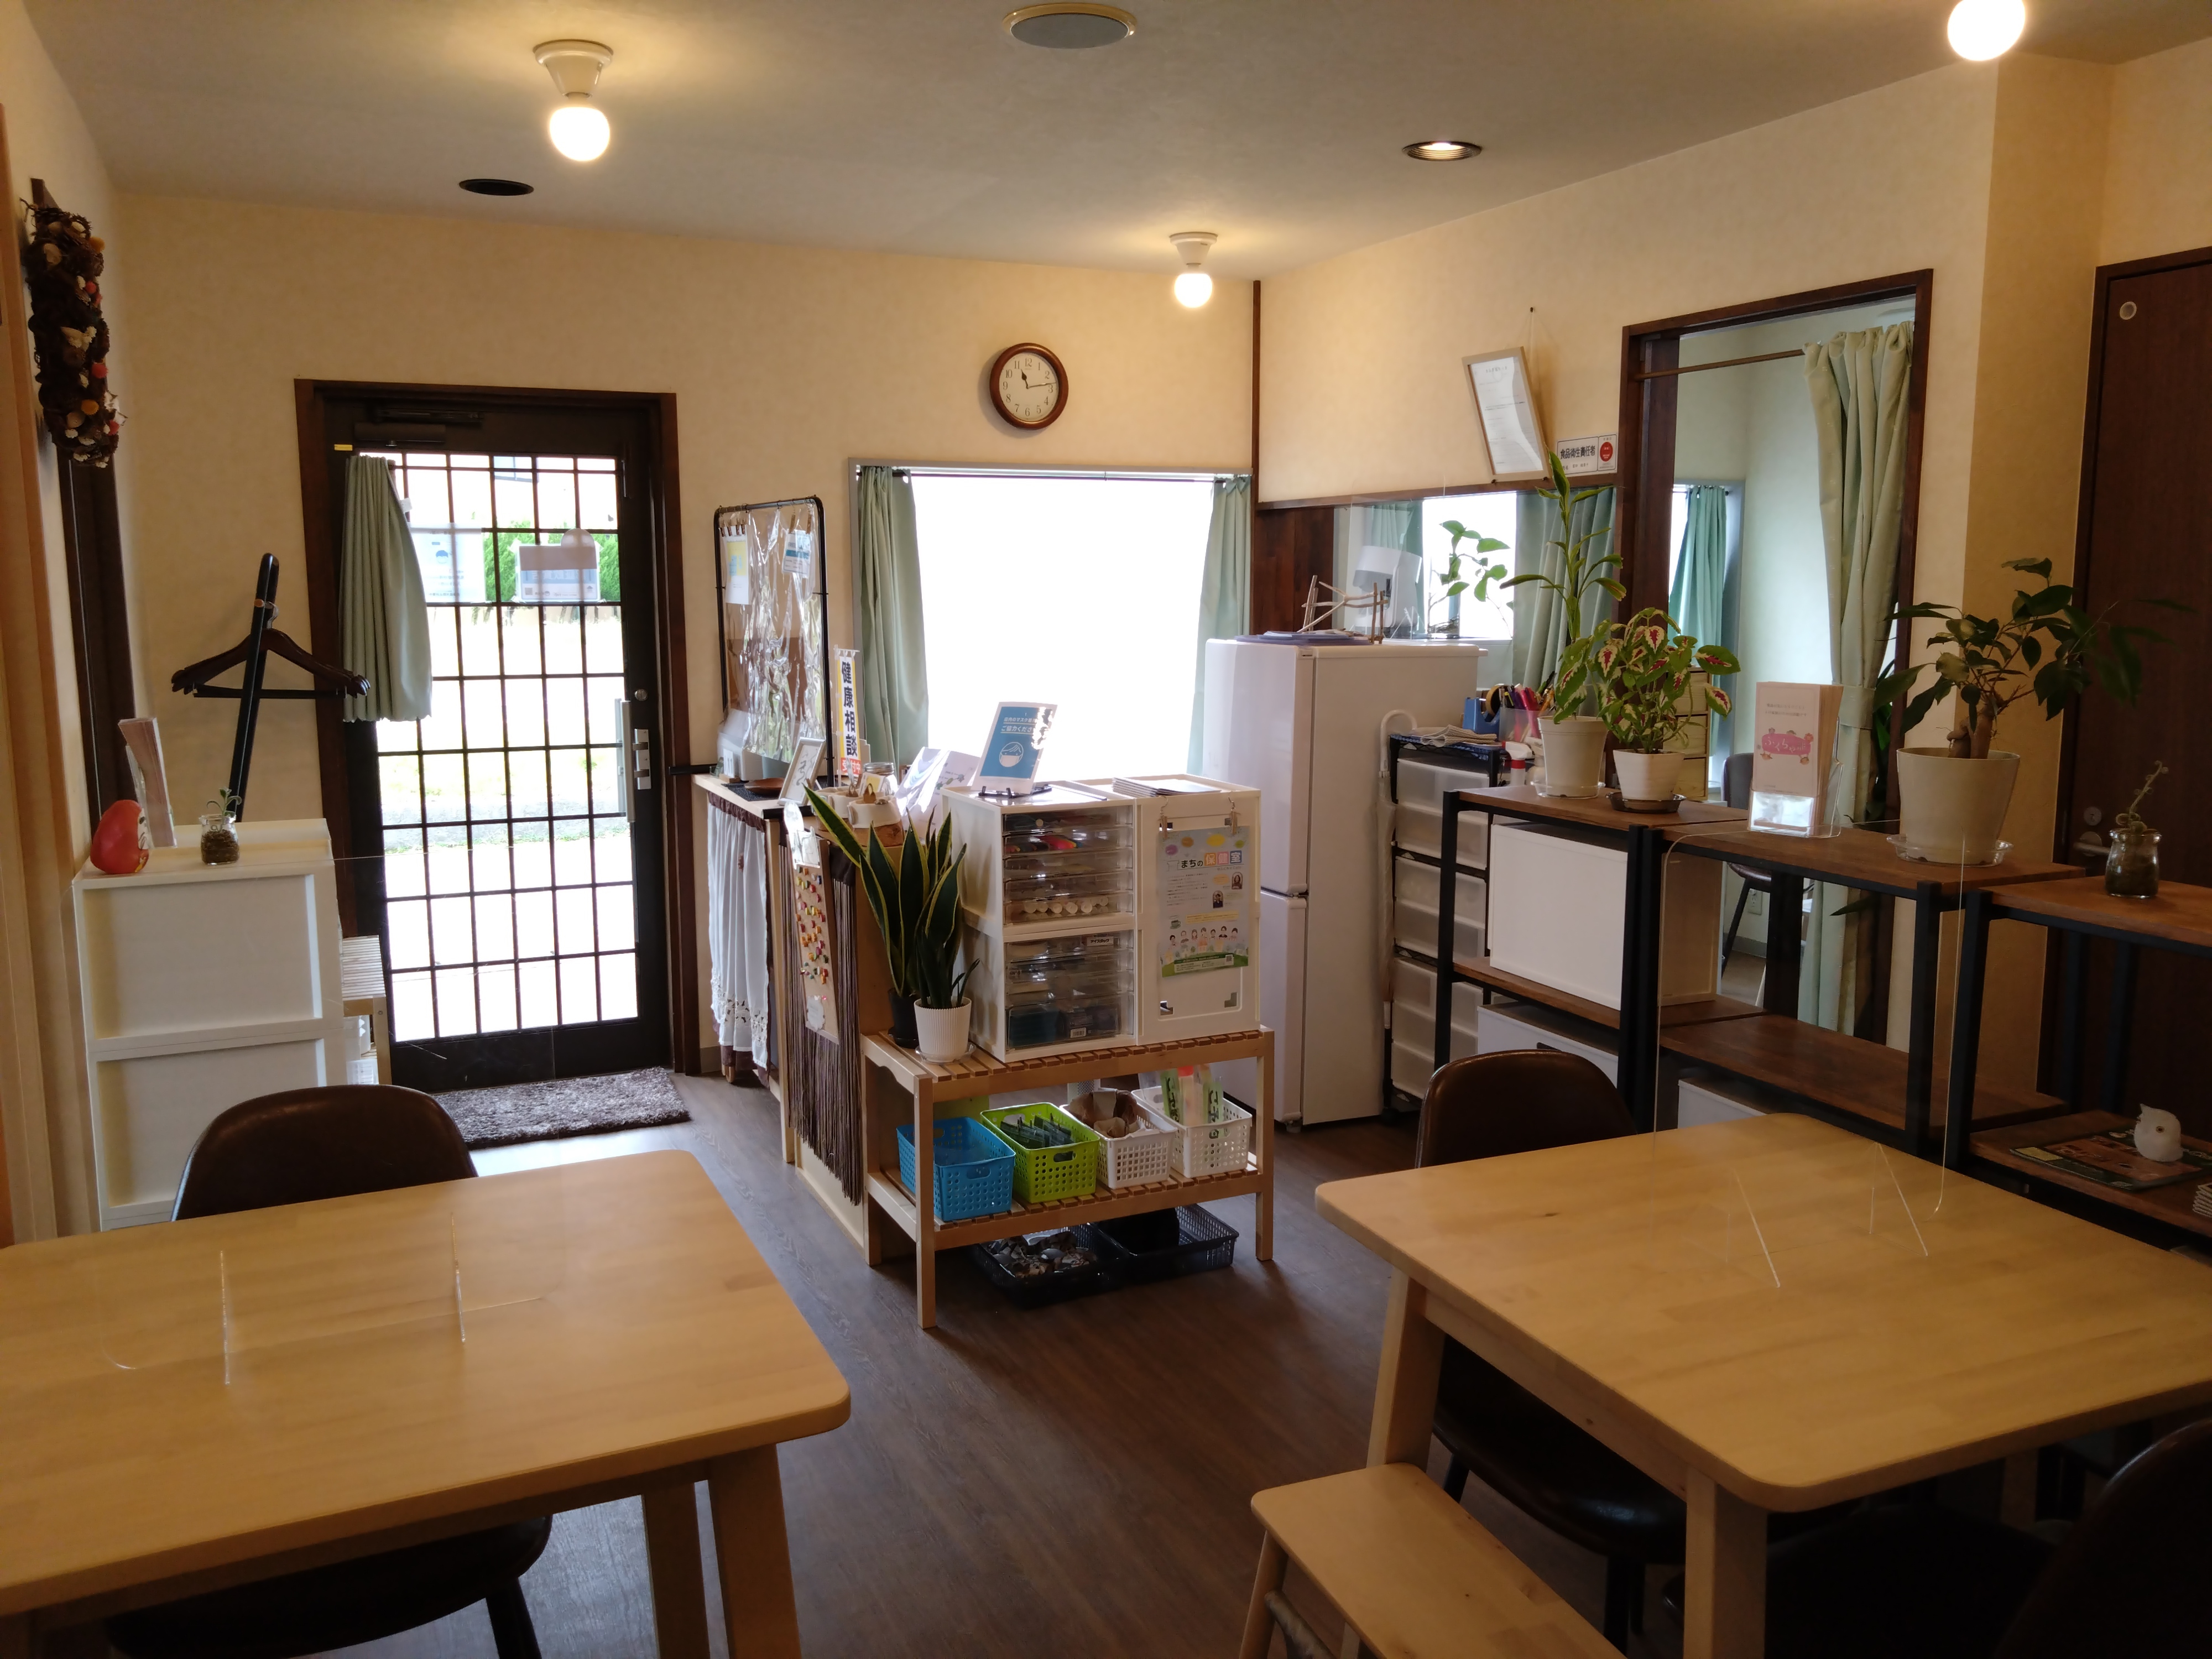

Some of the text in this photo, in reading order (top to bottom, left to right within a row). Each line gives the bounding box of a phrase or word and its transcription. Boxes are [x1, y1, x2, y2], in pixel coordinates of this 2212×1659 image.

[1014, 361, 1020, 369] 11
[1025, 358, 1032, 367] 12
[1005, 369, 1013, 378] 10
[1045, 371, 1050, 379] 2
[1003, 382, 1008, 390] 9
[1048, 384, 1053, 393] 3
[1006, 394, 1011, 403] 8
[1044, 397, 1049, 405] 4
[1014, 404, 1020, 413] 7
[1025, 408, 1030, 416] 6
[1036, 405, 1041, 414] 5
[1560, 445, 1595, 460] 食品衛生責任者
[842, 661, 858, 757] 健康相談
[1181, 852, 1241, 868] まちの保健室
